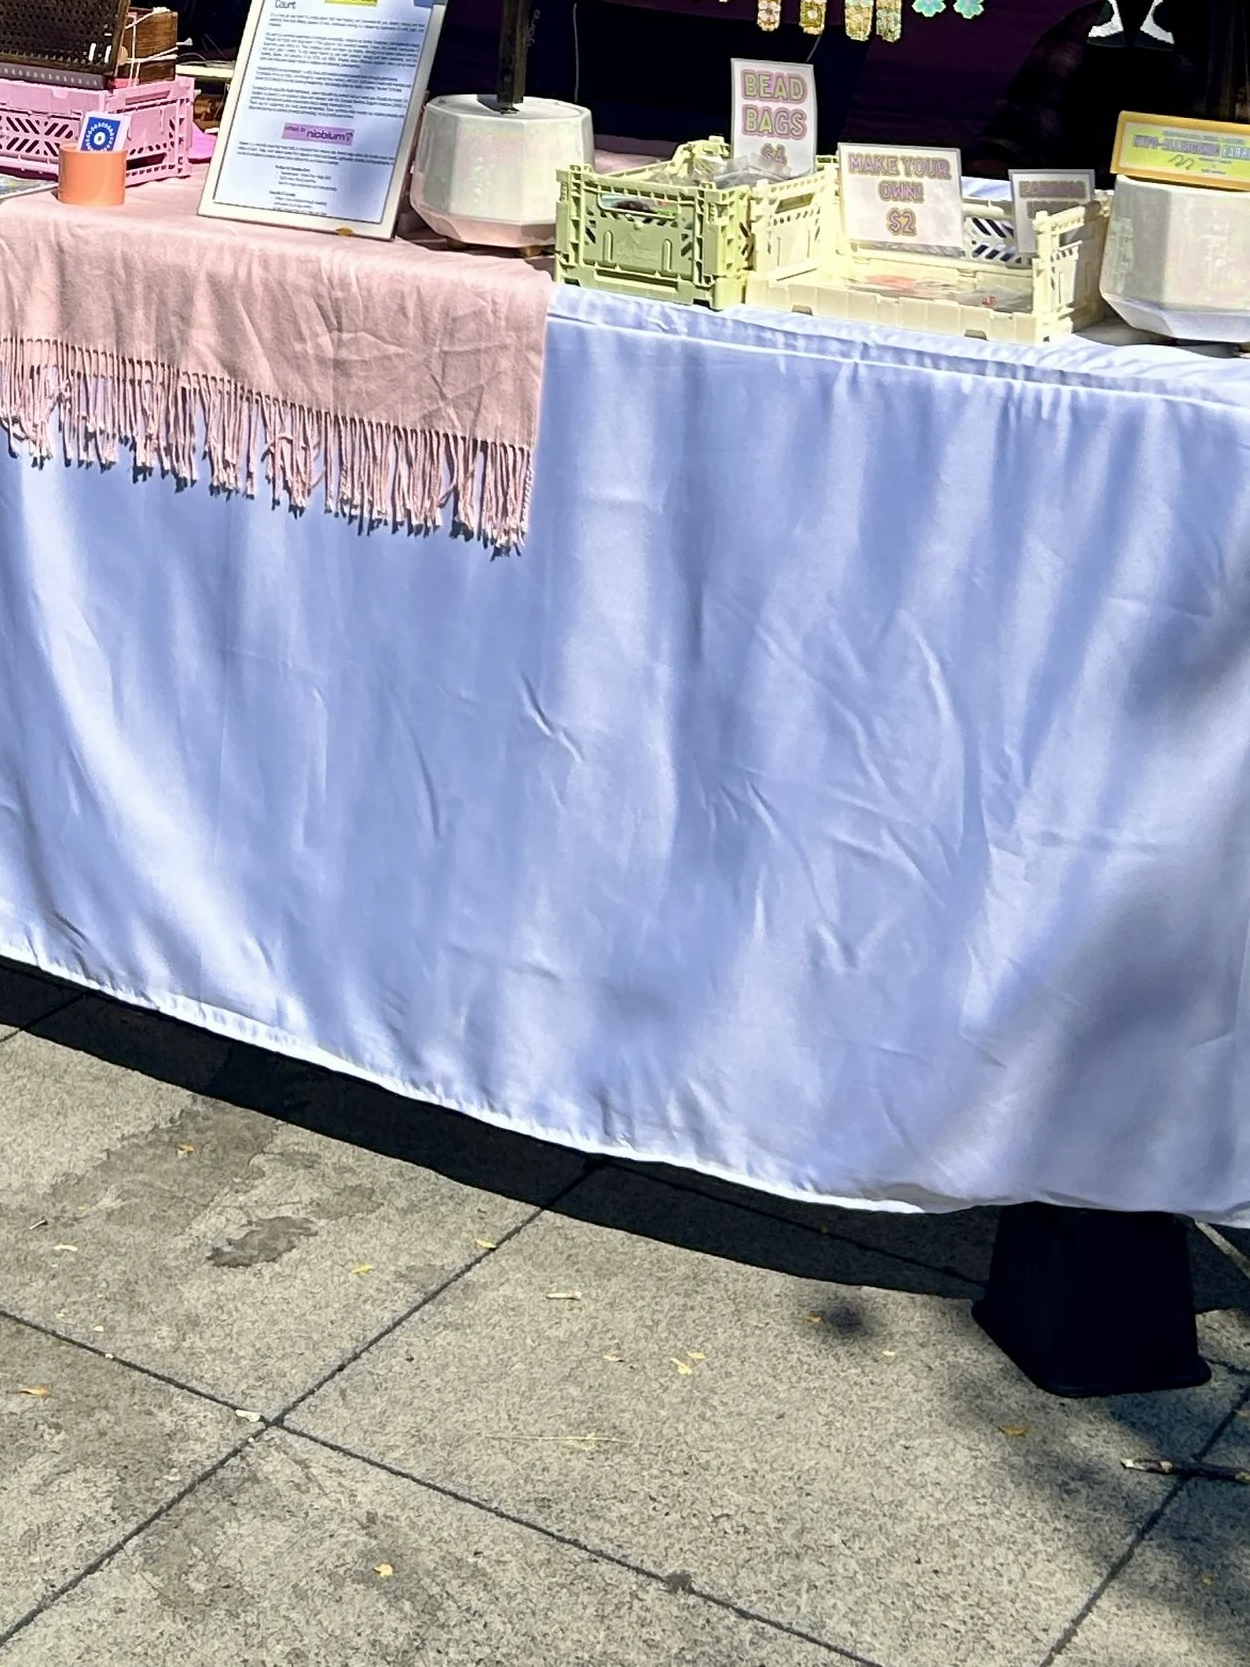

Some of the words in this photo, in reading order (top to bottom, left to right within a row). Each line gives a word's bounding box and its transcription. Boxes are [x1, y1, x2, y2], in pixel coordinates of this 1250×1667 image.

[741, 69, 808, 103] BEAD
[741, 104, 807, 140] BAGS
[760, 142, 787, 166] $4
[848, 153, 900, 176] MAKE
[901, 156, 952, 180] YOUR
[886, 207, 917, 236] $2
